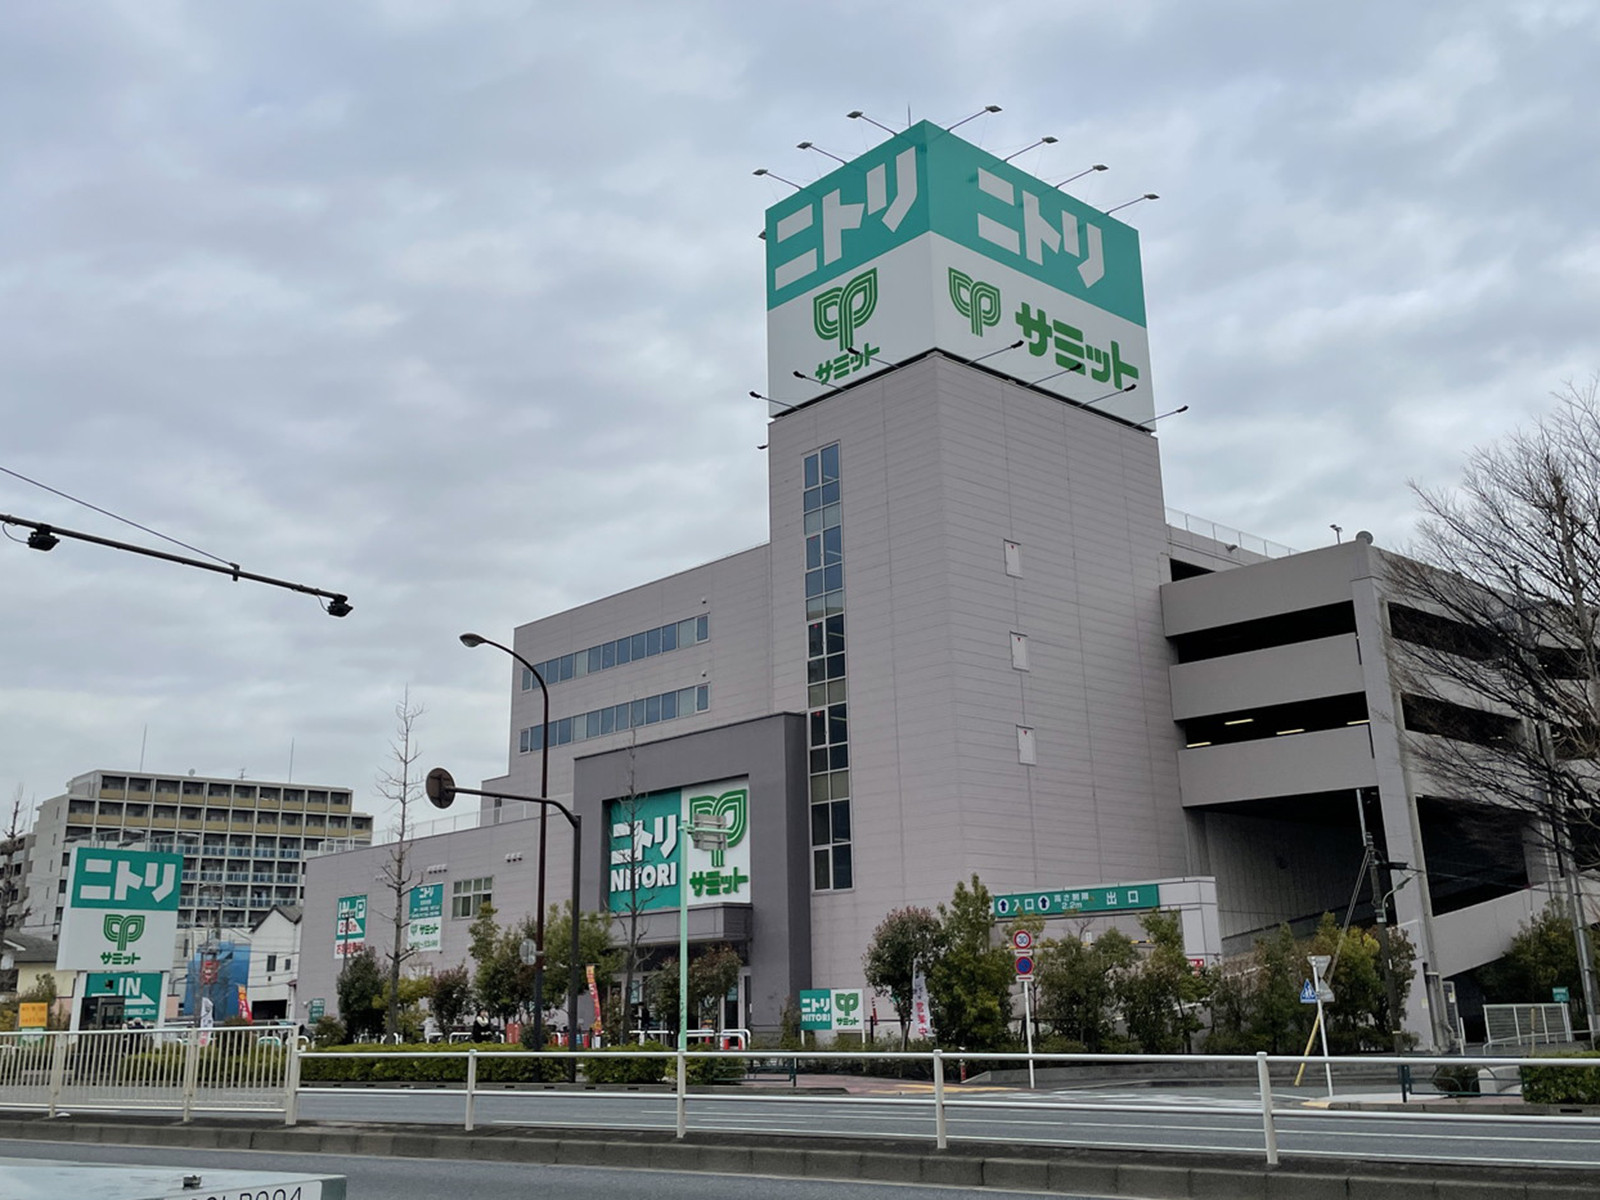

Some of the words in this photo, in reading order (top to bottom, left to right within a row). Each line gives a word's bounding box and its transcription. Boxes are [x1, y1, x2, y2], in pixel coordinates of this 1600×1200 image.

[775, 146, 917, 290] ニトリ
[978, 167, 1104, 288] ニトリ
[1015, 302, 1139, 390] サミット
[815, 342, 880, 385] サミット
[611, 814, 677, 865] ニトリ
[79, 859, 176, 903] ニトリ
[610, 861, 677, 892] NITORI
[689, 867, 749, 897] サミット
[1013, 898, 1034, 911] 入口
[1106, 890, 1139, 905] 出口
[100, 952, 141, 965] サミット
[117, 977, 142, 996] IN
[802, 997, 830, 1012] ニトリ
[802, 1013, 831, 1022] NITORI
[836, 1017, 859, 1026] サミット
